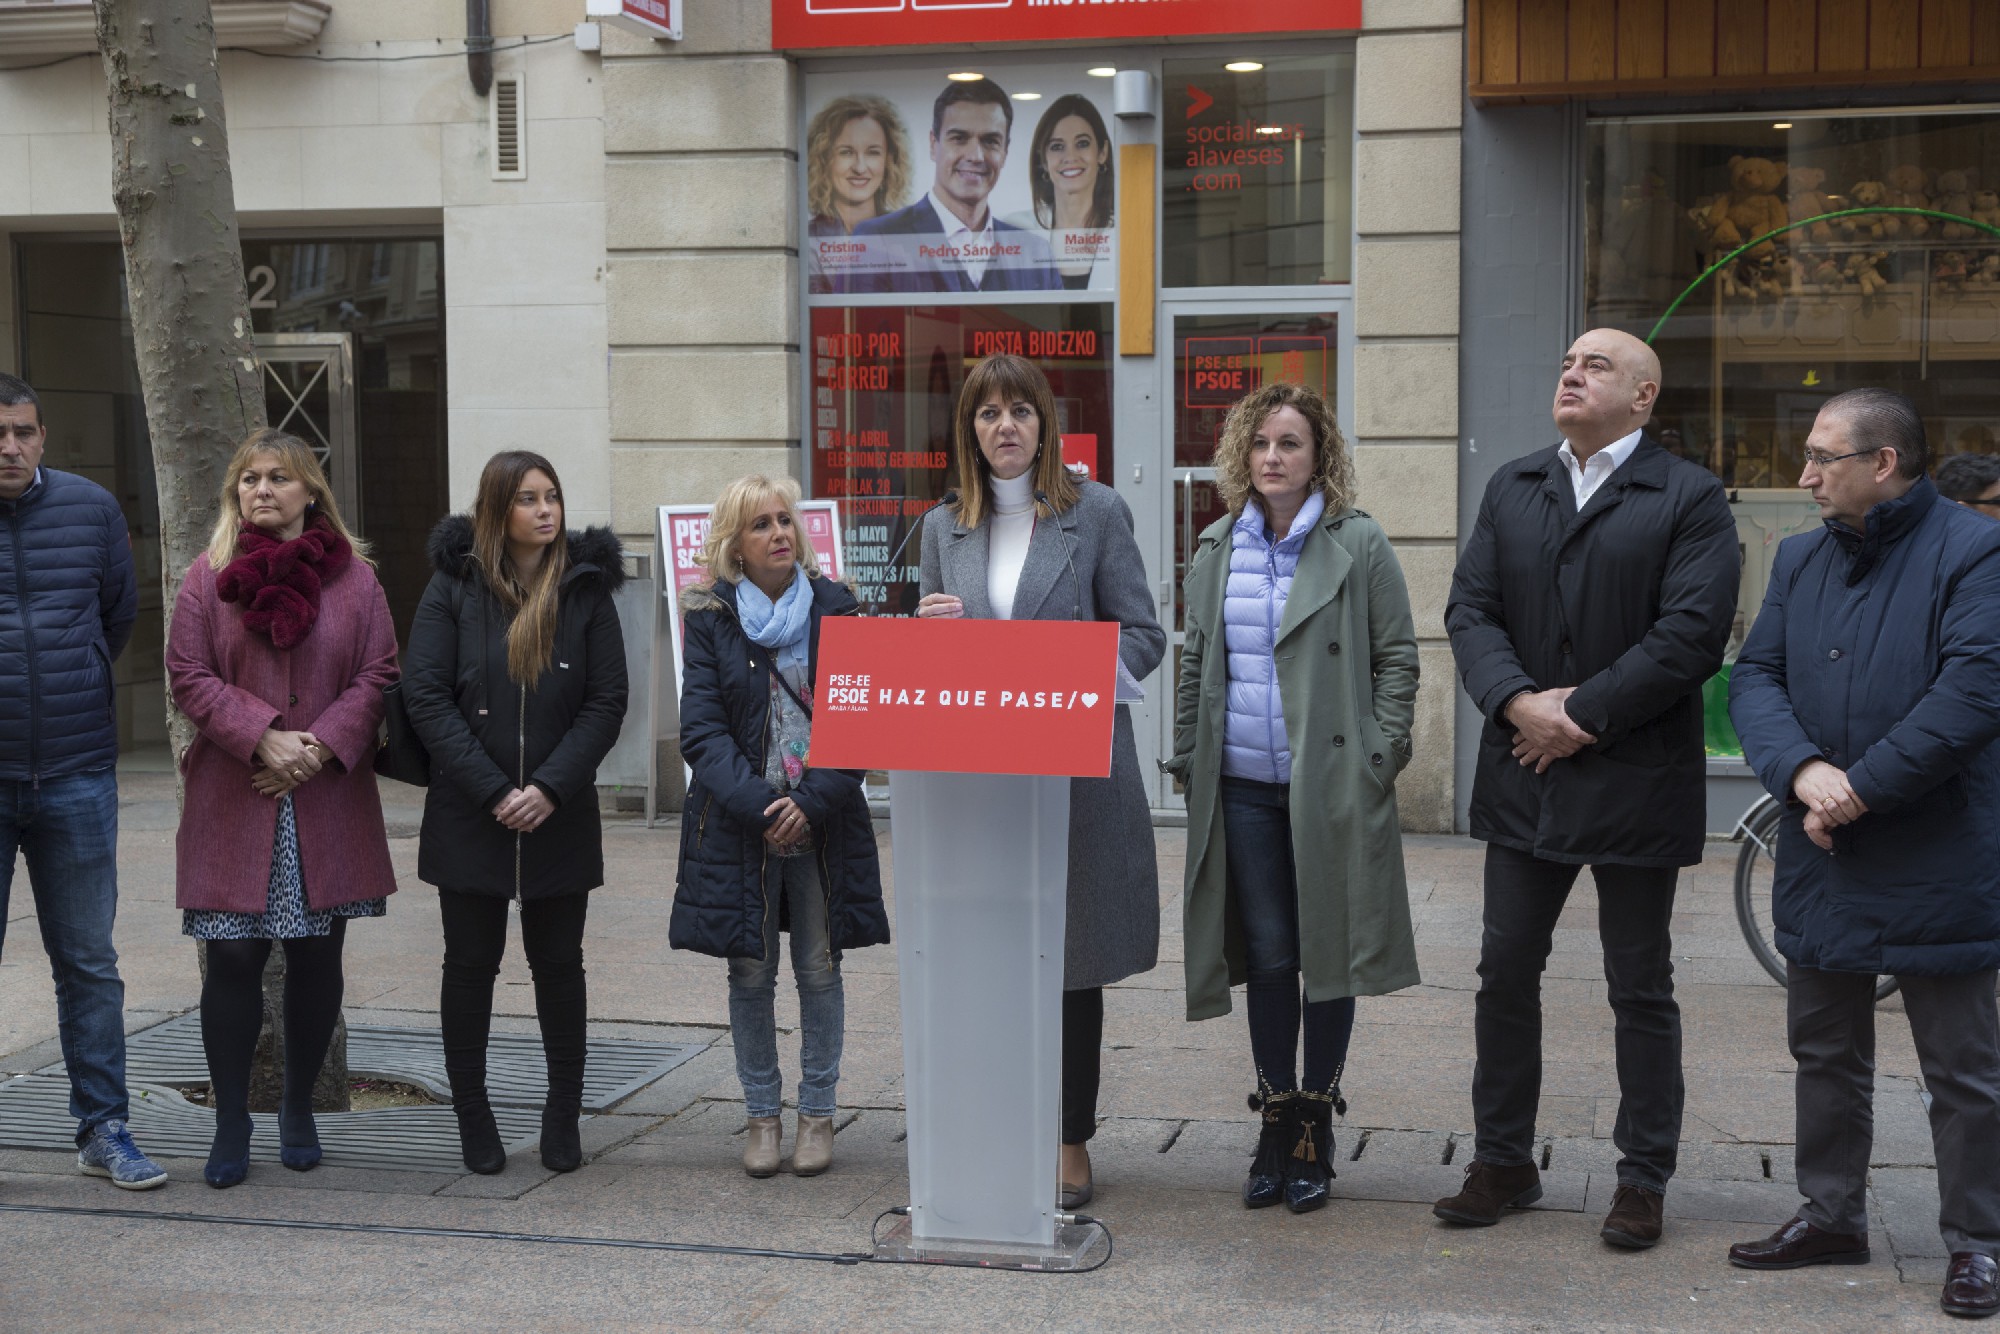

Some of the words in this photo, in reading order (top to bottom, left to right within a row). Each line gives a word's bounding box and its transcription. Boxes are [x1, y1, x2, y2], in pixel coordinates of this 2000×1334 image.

[1186, 119, 1305, 143] socialistas
[1186, 145, 1284, 167] alaveses
[1186, 172, 1241, 191] .com
[819, 241, 867, 253] Cristina
[1064, 233, 1110, 245] Maider
[919, 243, 960, 257] Pedro
[963, 241, 1022, 256] Sánchez
[828, 332, 862, 358] VOTO
[868, 332, 901, 358] POR
[974, 330, 1023, 355] POSTA
[1029, 329, 1096, 356] BIDEZKO
[1195, 355, 1243, 368] PSE-EE
[828, 365, 889, 390] CORREO
[1195, 371, 1243, 390] PSOE
[860, 430, 890, 447] ABRIL
[828, 451, 887, 468] ELECCIONES
[889, 451, 947, 469] GENERALES
[877, 479, 891, 495] 28
[859, 525, 888, 543] MAYO
[829, 674, 871, 687] PSE-EE
[828, 687, 869, 704] PSOE
[879, 688, 926, 705] HAZ
[939, 689, 987, 707] QUE
